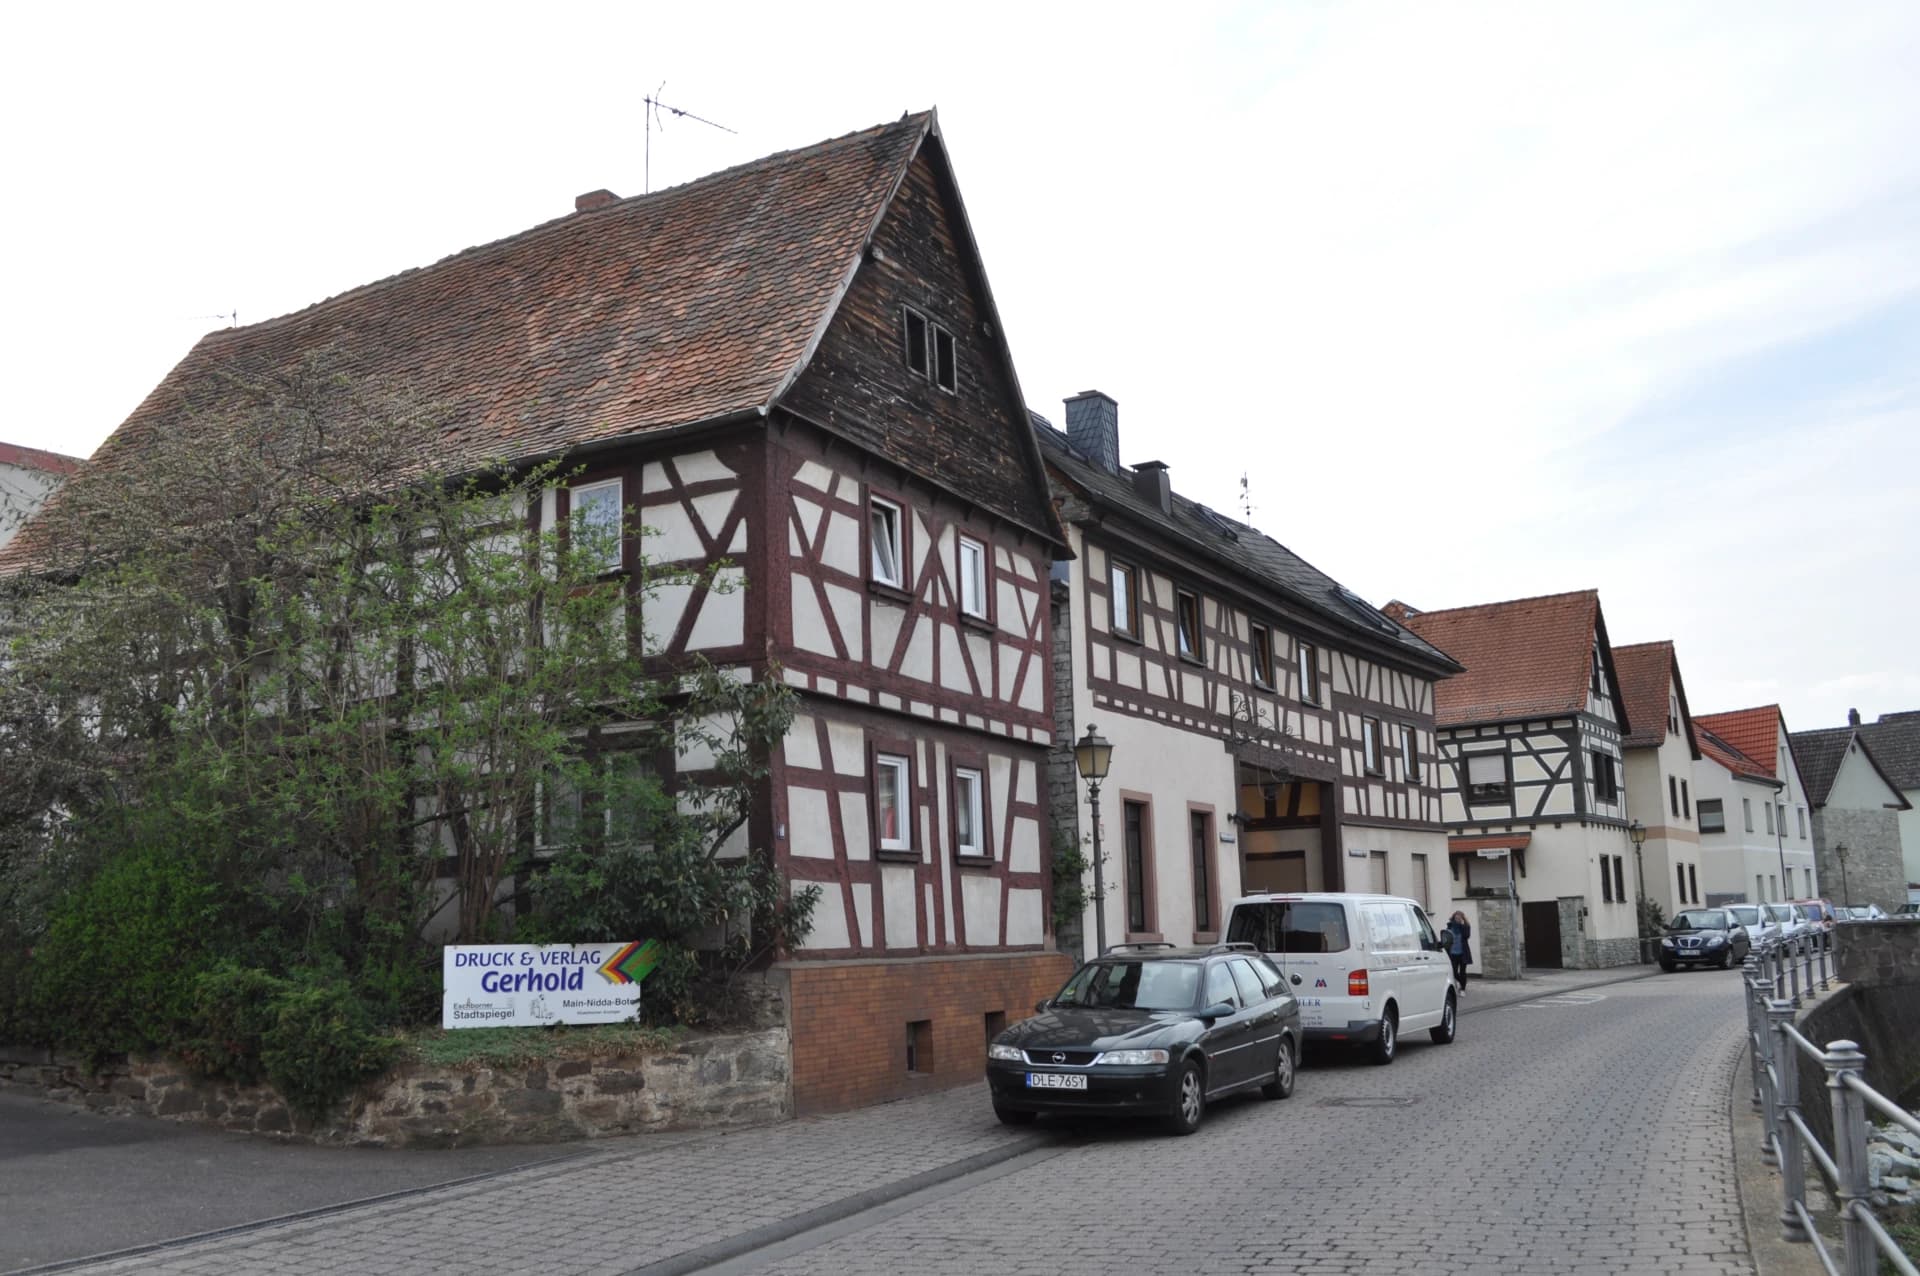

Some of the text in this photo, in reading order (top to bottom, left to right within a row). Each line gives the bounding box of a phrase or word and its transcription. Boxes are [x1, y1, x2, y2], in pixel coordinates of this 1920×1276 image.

[455, 950, 601, 967] DRUCK & VERLAG
[481, 966, 584, 993] Gerhold
[453, 1009, 515, 1021] Stadtspiegel
